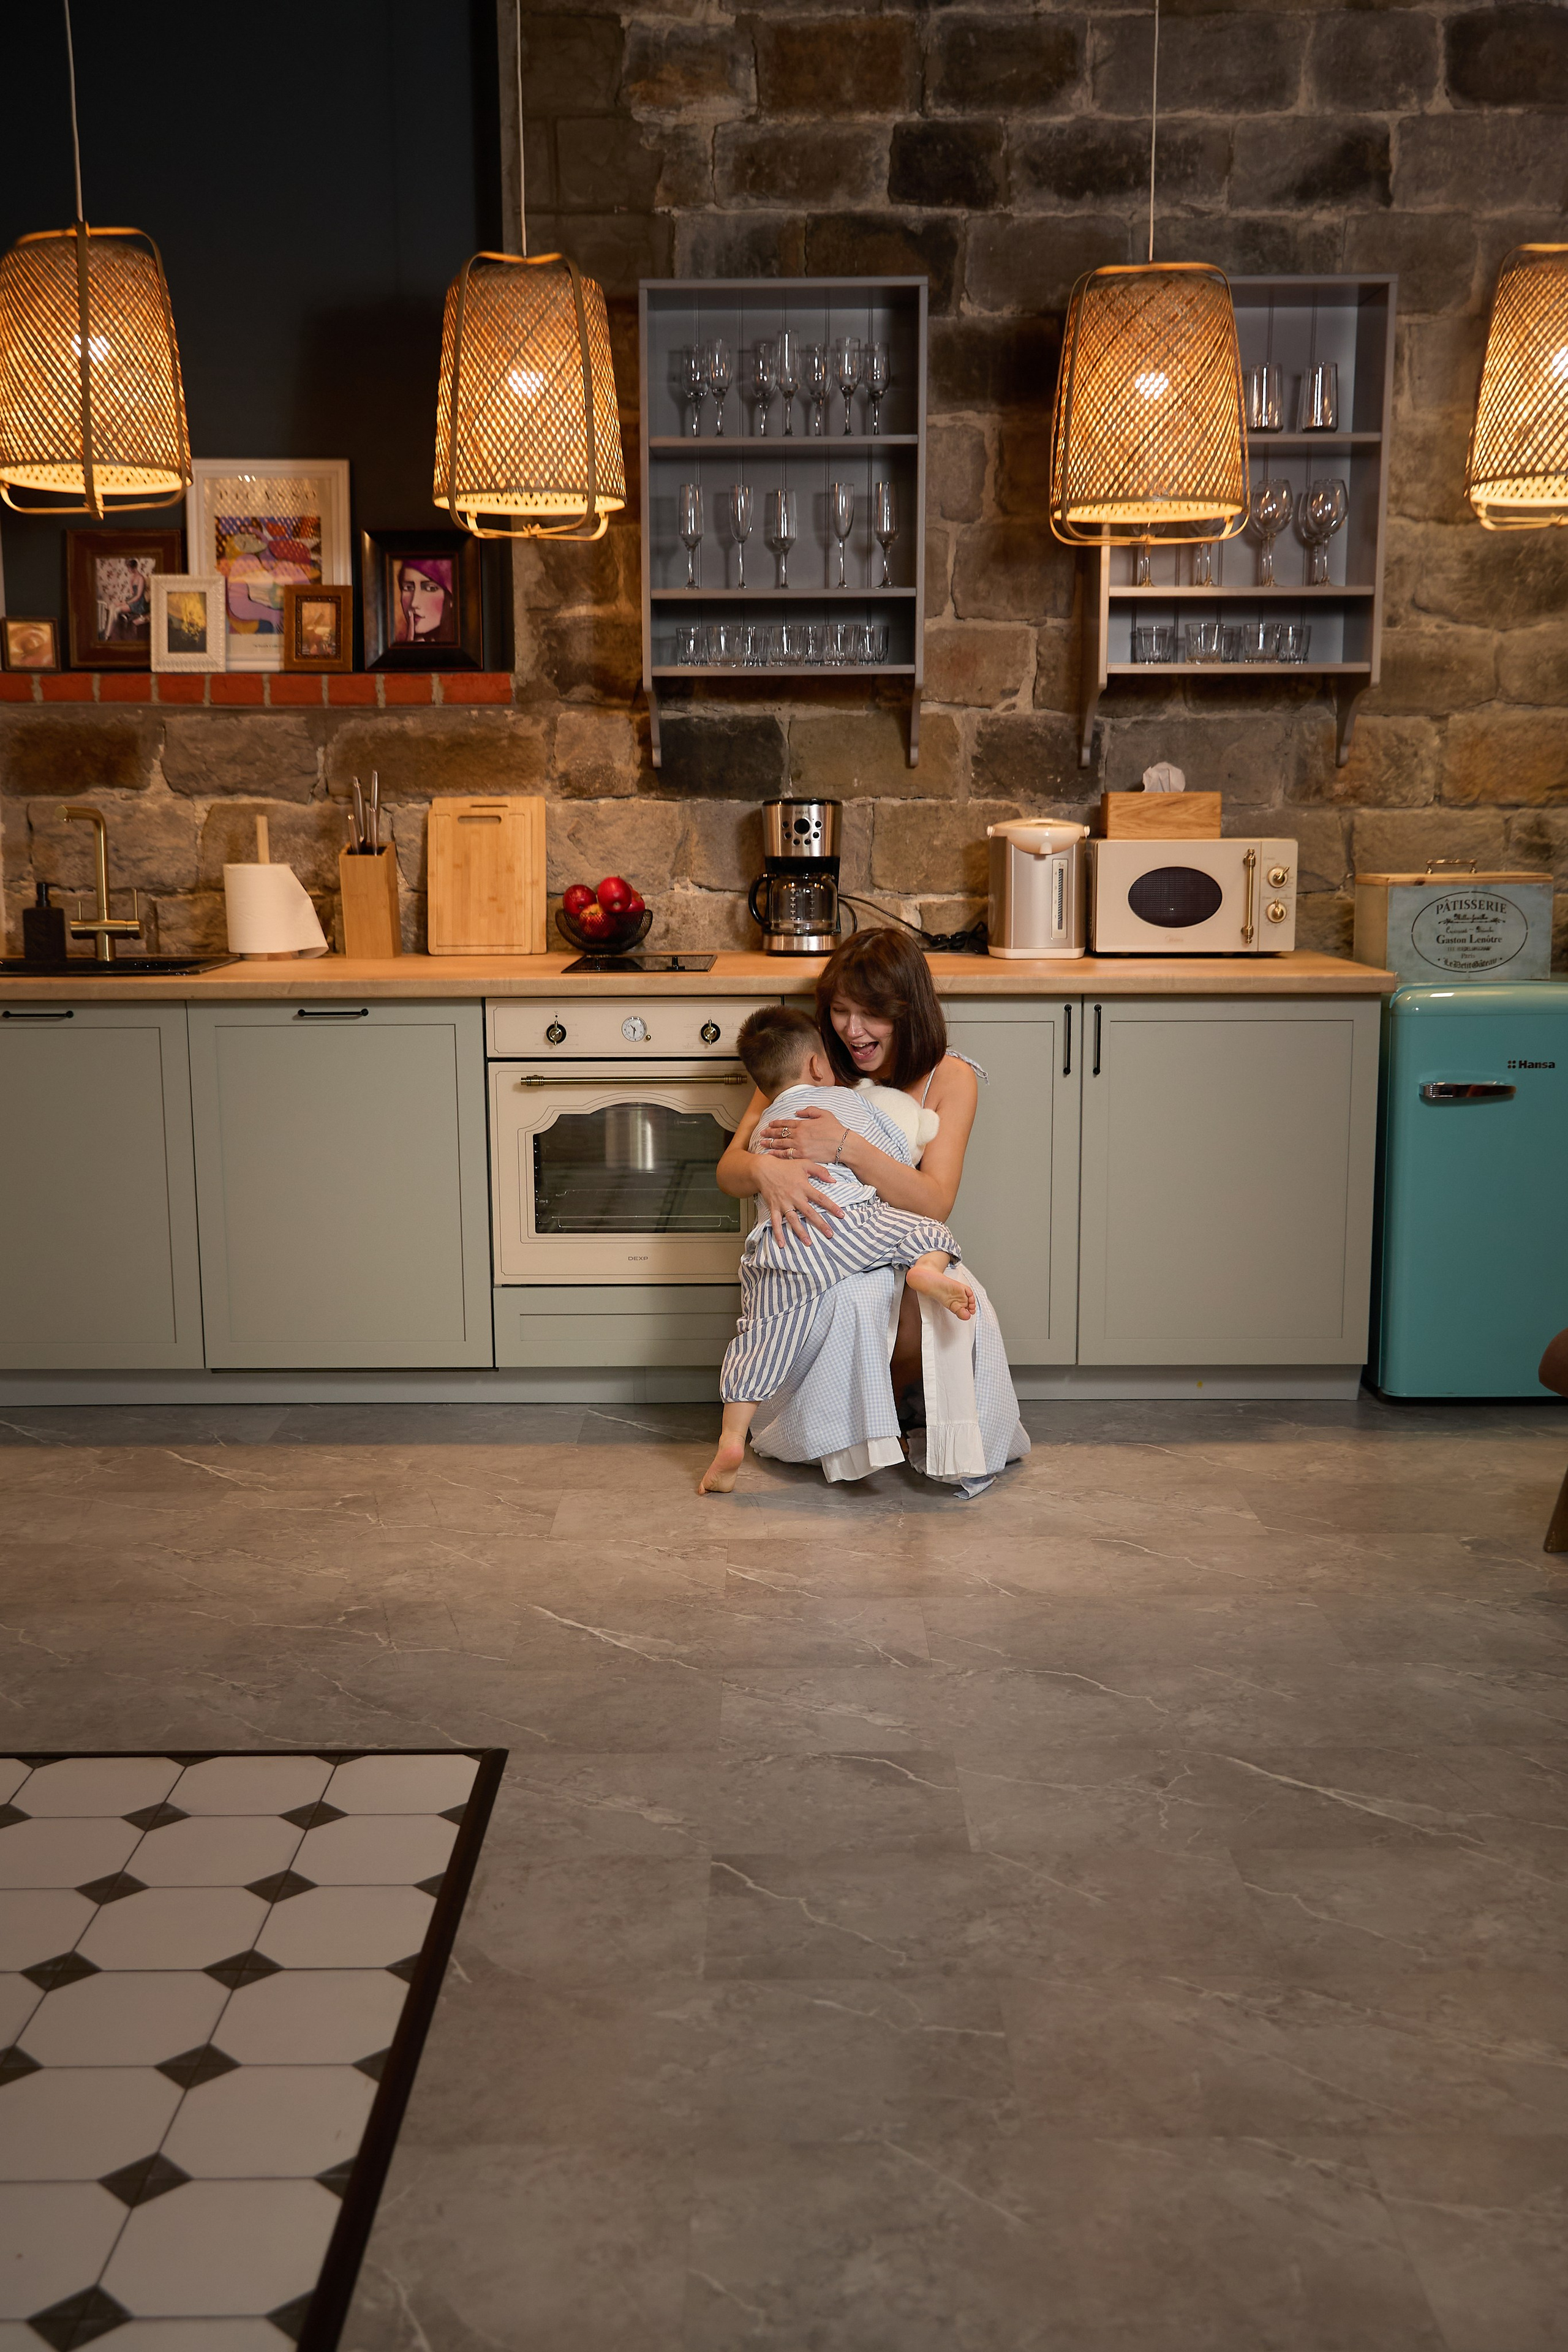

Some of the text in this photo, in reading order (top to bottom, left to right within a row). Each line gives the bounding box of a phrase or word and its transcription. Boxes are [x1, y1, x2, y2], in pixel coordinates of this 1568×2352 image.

[1436, 899, 1507, 914] PÂTISSERIE
[1436, 934, 1502, 944] Gaston Lenôtre
[1518, 1060, 1556, 1069] Hansa
